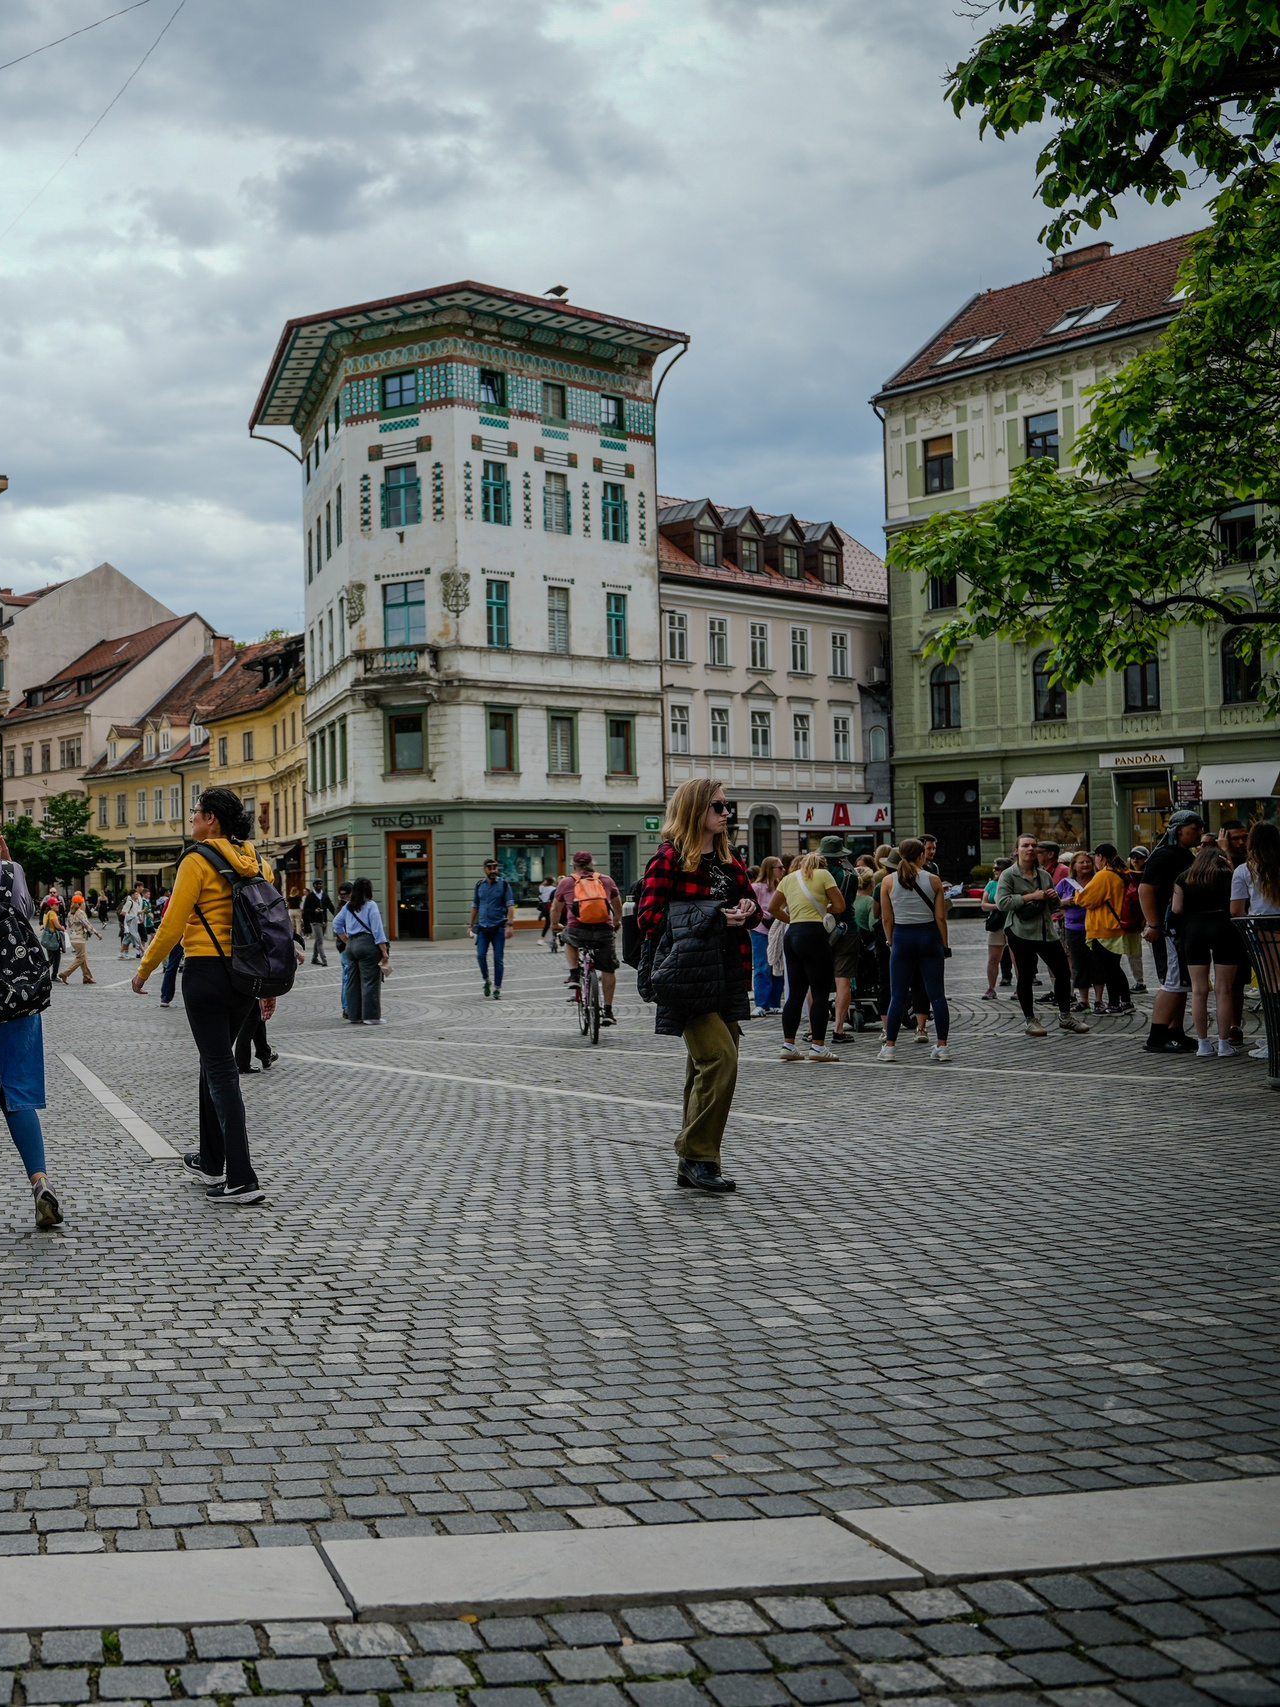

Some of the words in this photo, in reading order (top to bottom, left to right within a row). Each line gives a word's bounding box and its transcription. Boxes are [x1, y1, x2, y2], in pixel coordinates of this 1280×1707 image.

[1114, 753, 1166, 766] PANDORA
[1215, 777, 1255, 785] PANDORA
[371, 816, 398, 827] STEN
[414, 814, 444, 825] TIME
[805, 806, 814, 822] A1
[874, 806, 888, 822] A1
